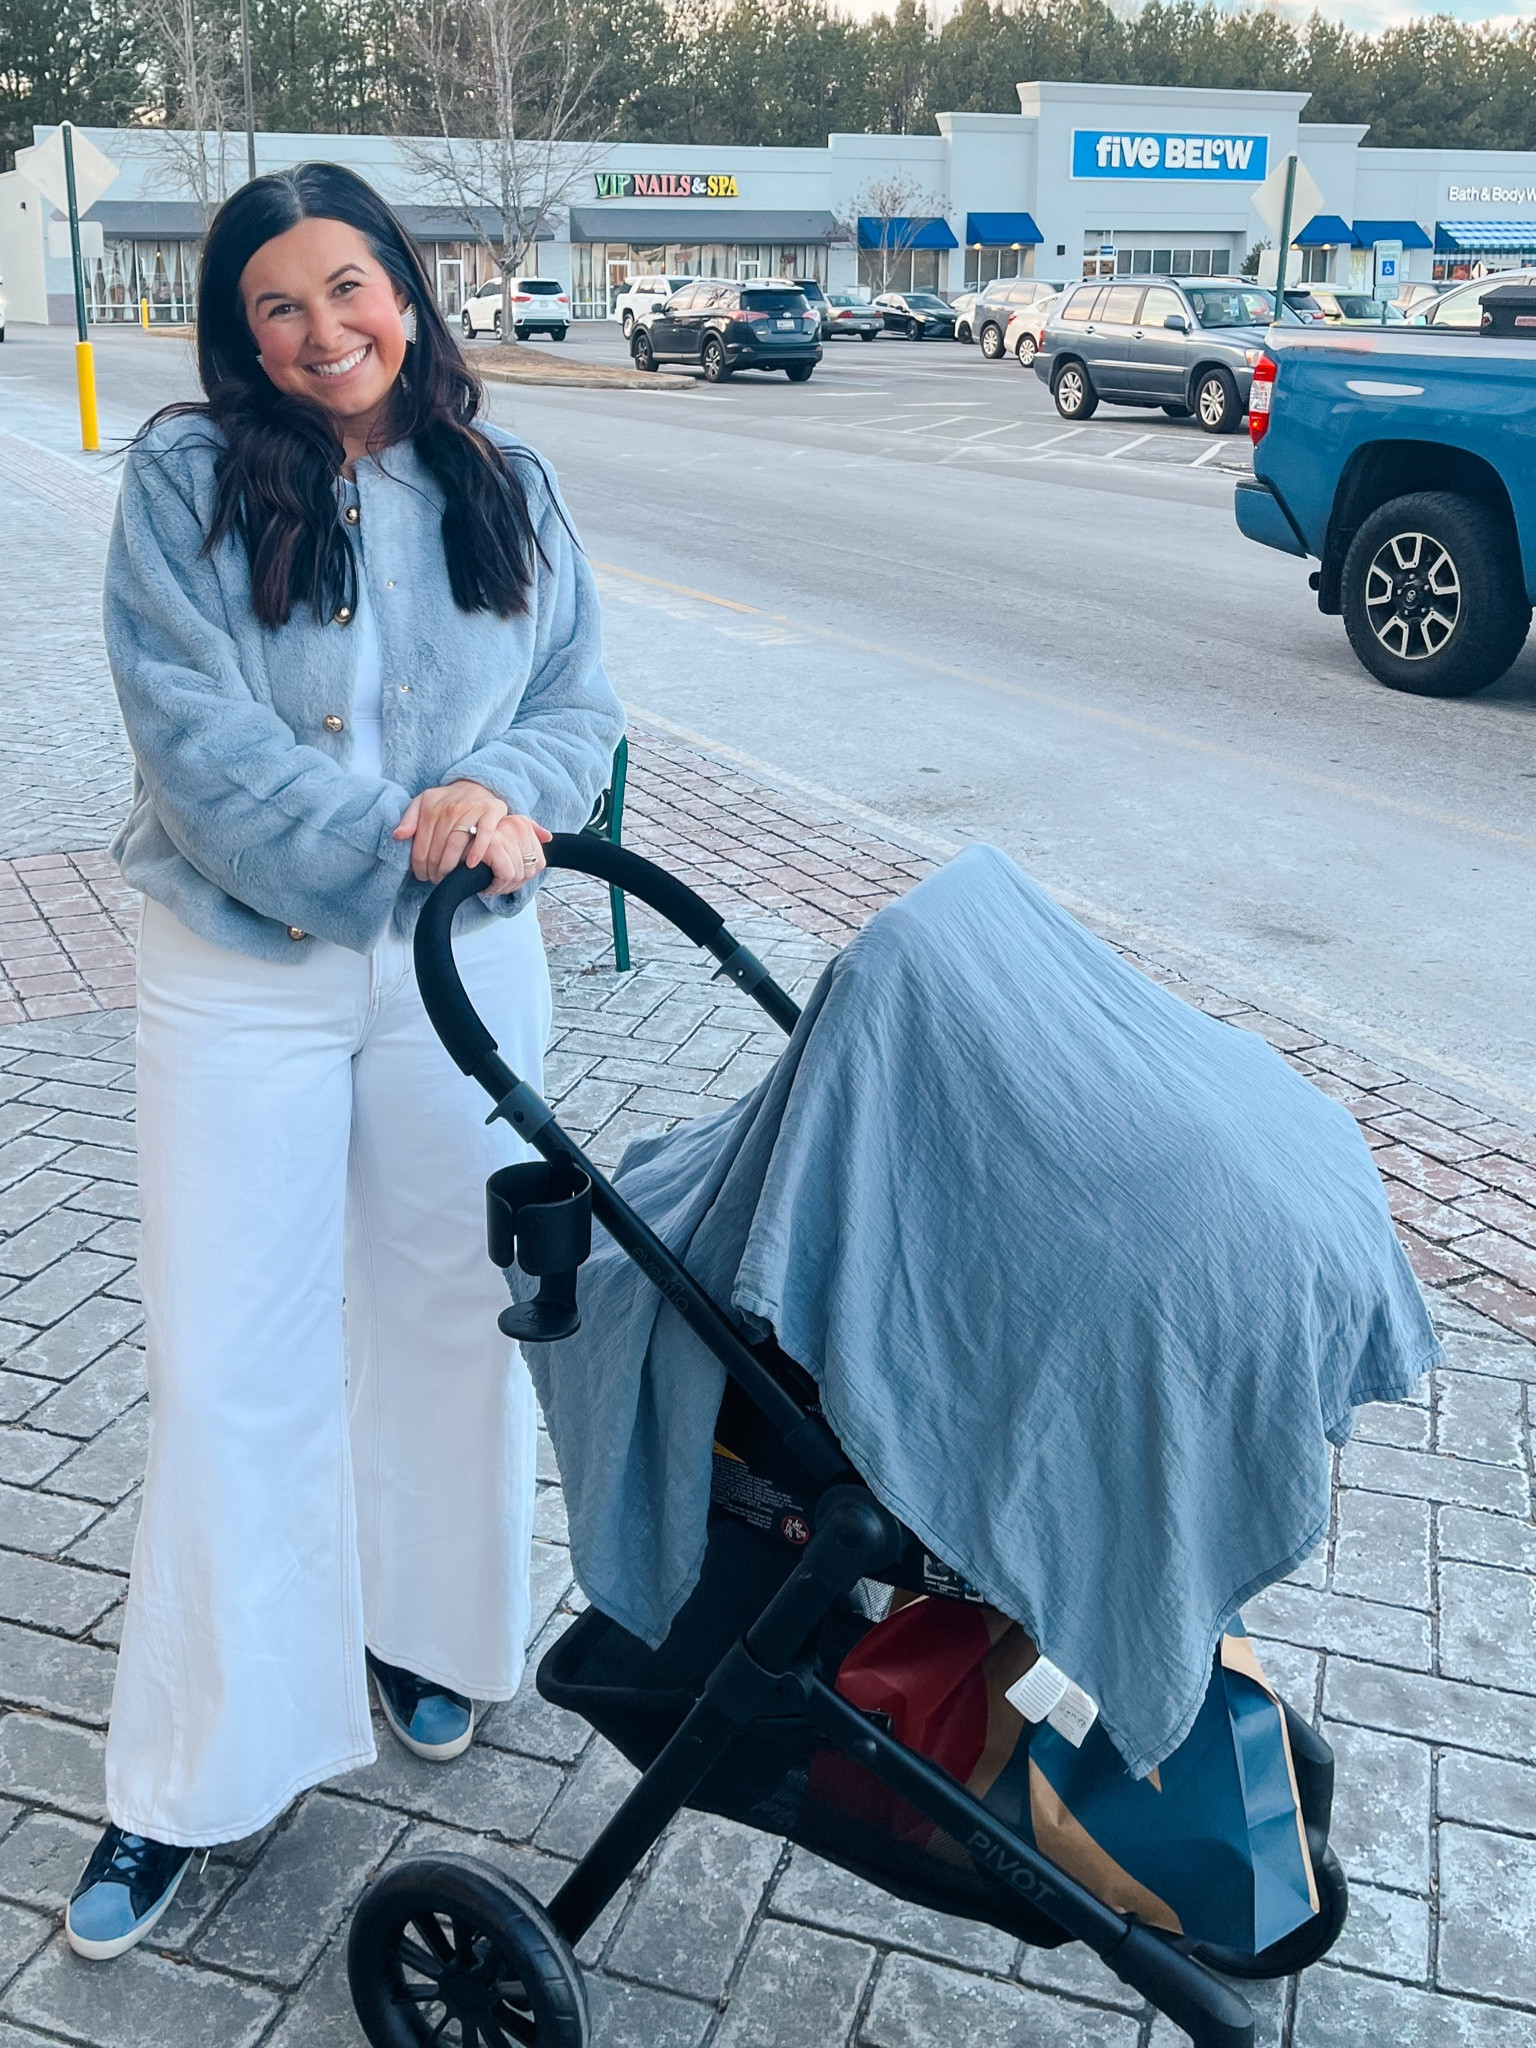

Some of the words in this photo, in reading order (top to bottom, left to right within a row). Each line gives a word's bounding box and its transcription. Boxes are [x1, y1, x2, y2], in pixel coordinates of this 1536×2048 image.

[1096, 136, 1161, 169] five
[1165, 138, 1254, 170] BELOW
[595, 174, 631, 196] VIP
[1448, 186, 1480, 202] Bath
[1480, 187, 1491, 202] &
[1492, 187, 1526, 205] Body
[632, 1246, 689, 1312] evenflo
[967, 1829, 1058, 1901] PIVOT
